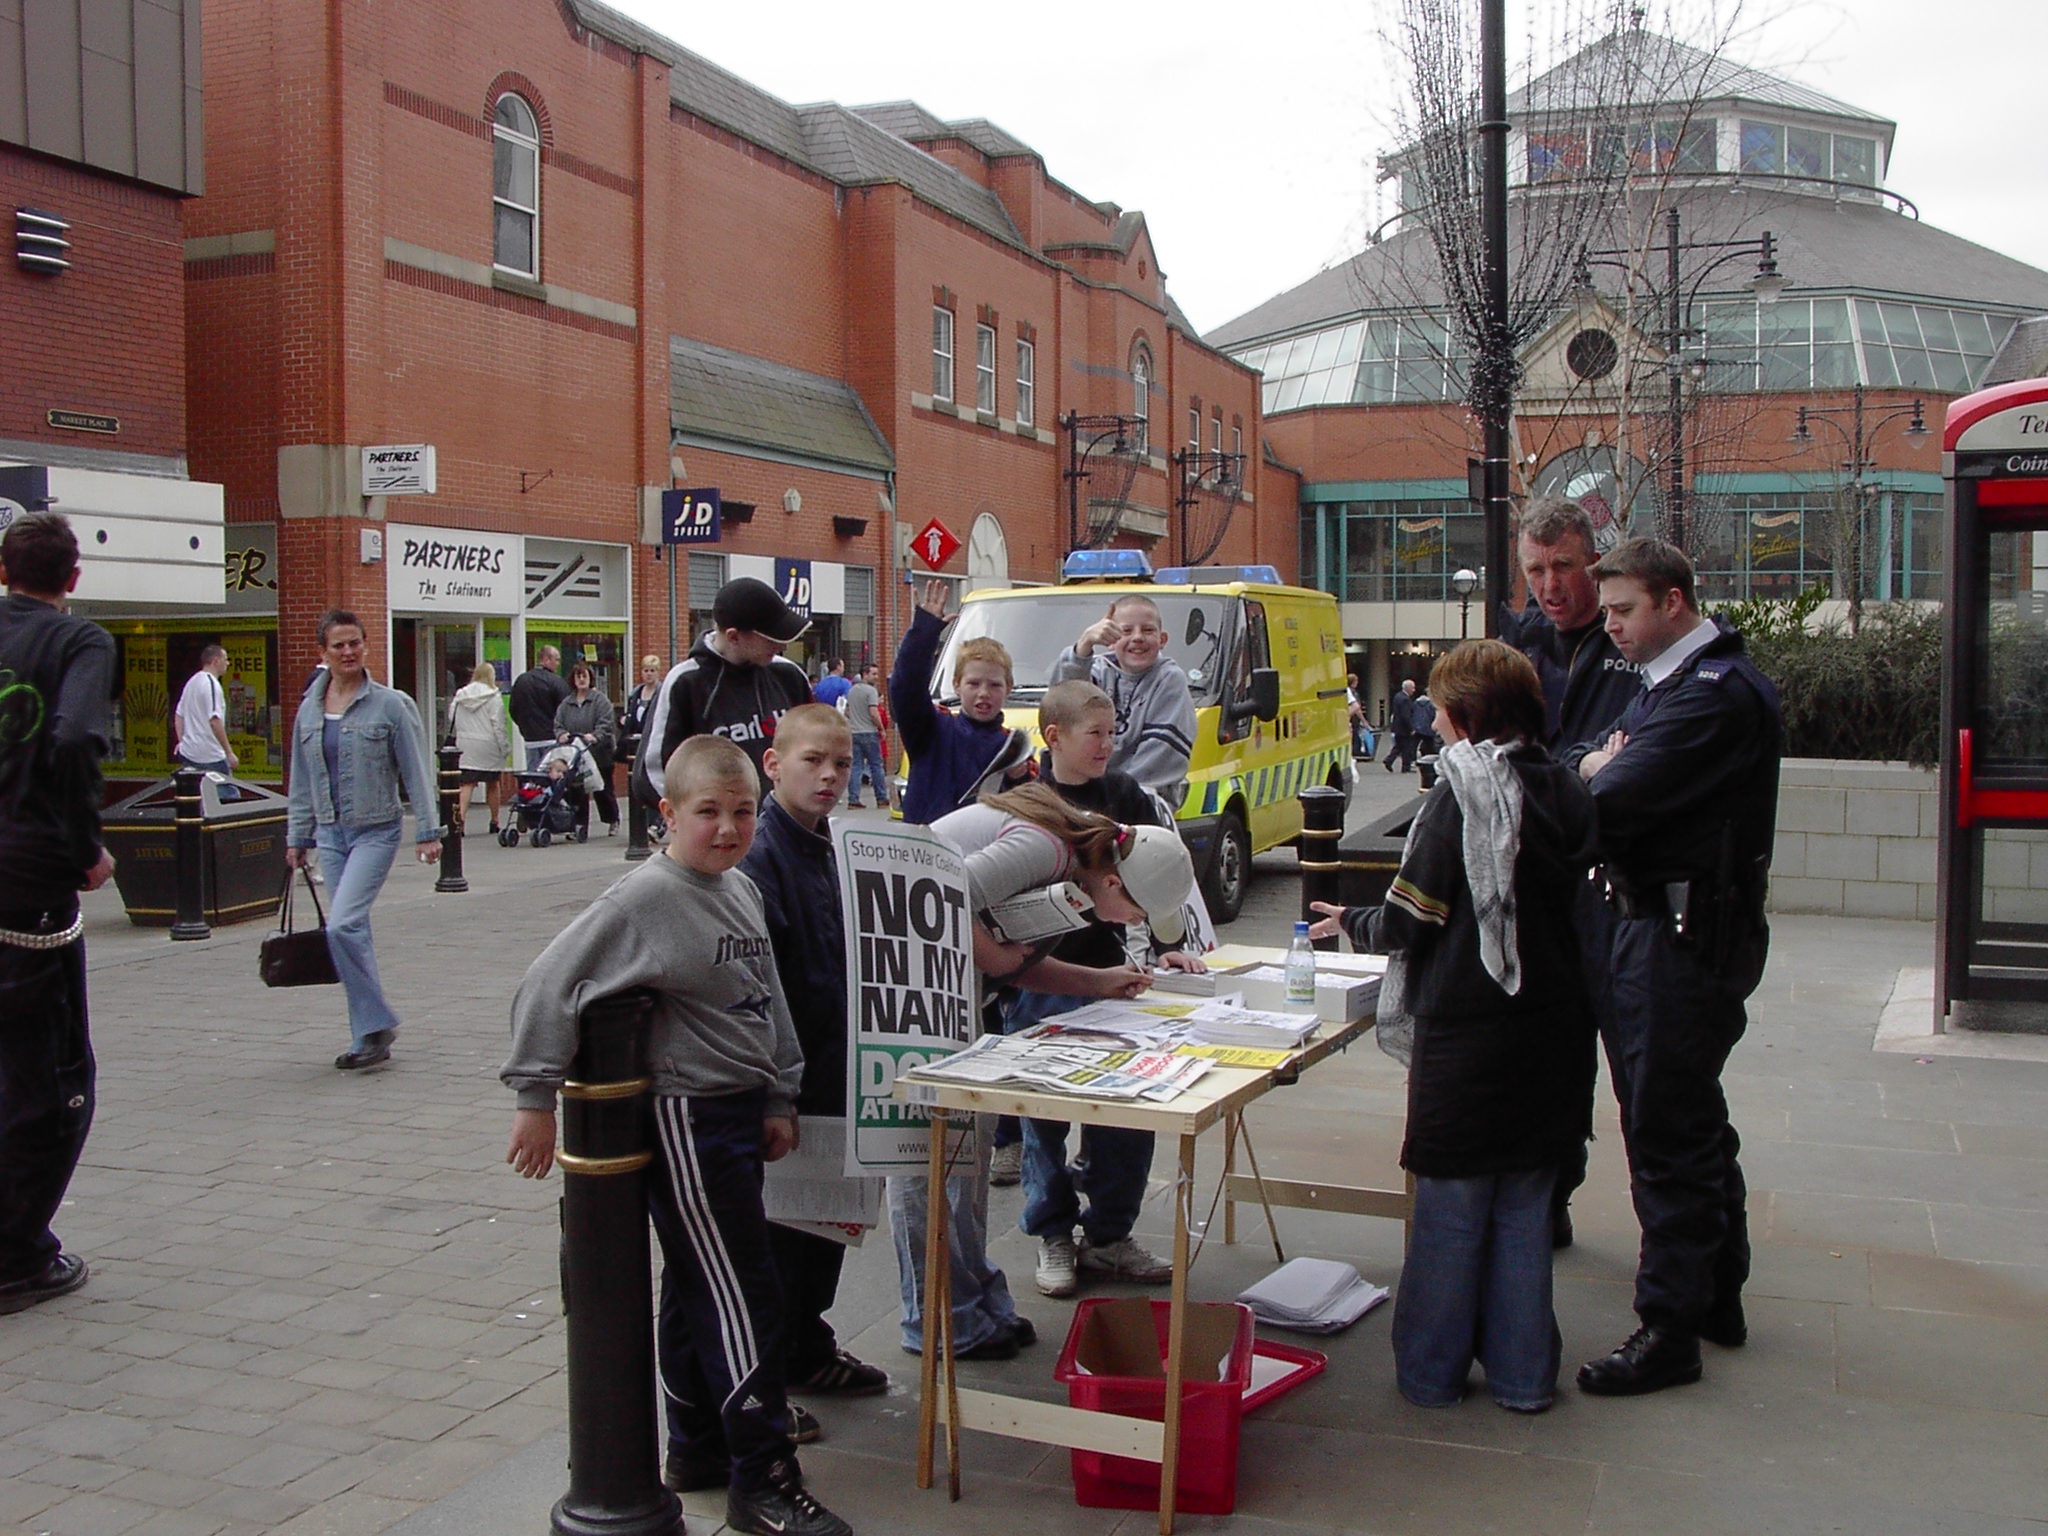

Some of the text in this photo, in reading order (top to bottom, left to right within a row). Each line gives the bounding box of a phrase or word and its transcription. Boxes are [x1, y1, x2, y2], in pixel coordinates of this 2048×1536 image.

[368, 451, 419, 463] PARTNERS
[674, 526, 711, 537] SPORTS
[403, 539, 504, 574] PARTNERS
[418, 578, 492, 597] The Stationers
[129, 658, 164, 672] FREE
[136, 749, 157, 759] Pens
[851, 840, 885, 861] Stop
[888, 844, 909, 862] the
[911, 848, 934, 866] War
[855, 869, 965, 949] NOT
[860, 936, 967, 996] IN MY
[861, 985, 969, 1043] NAME
